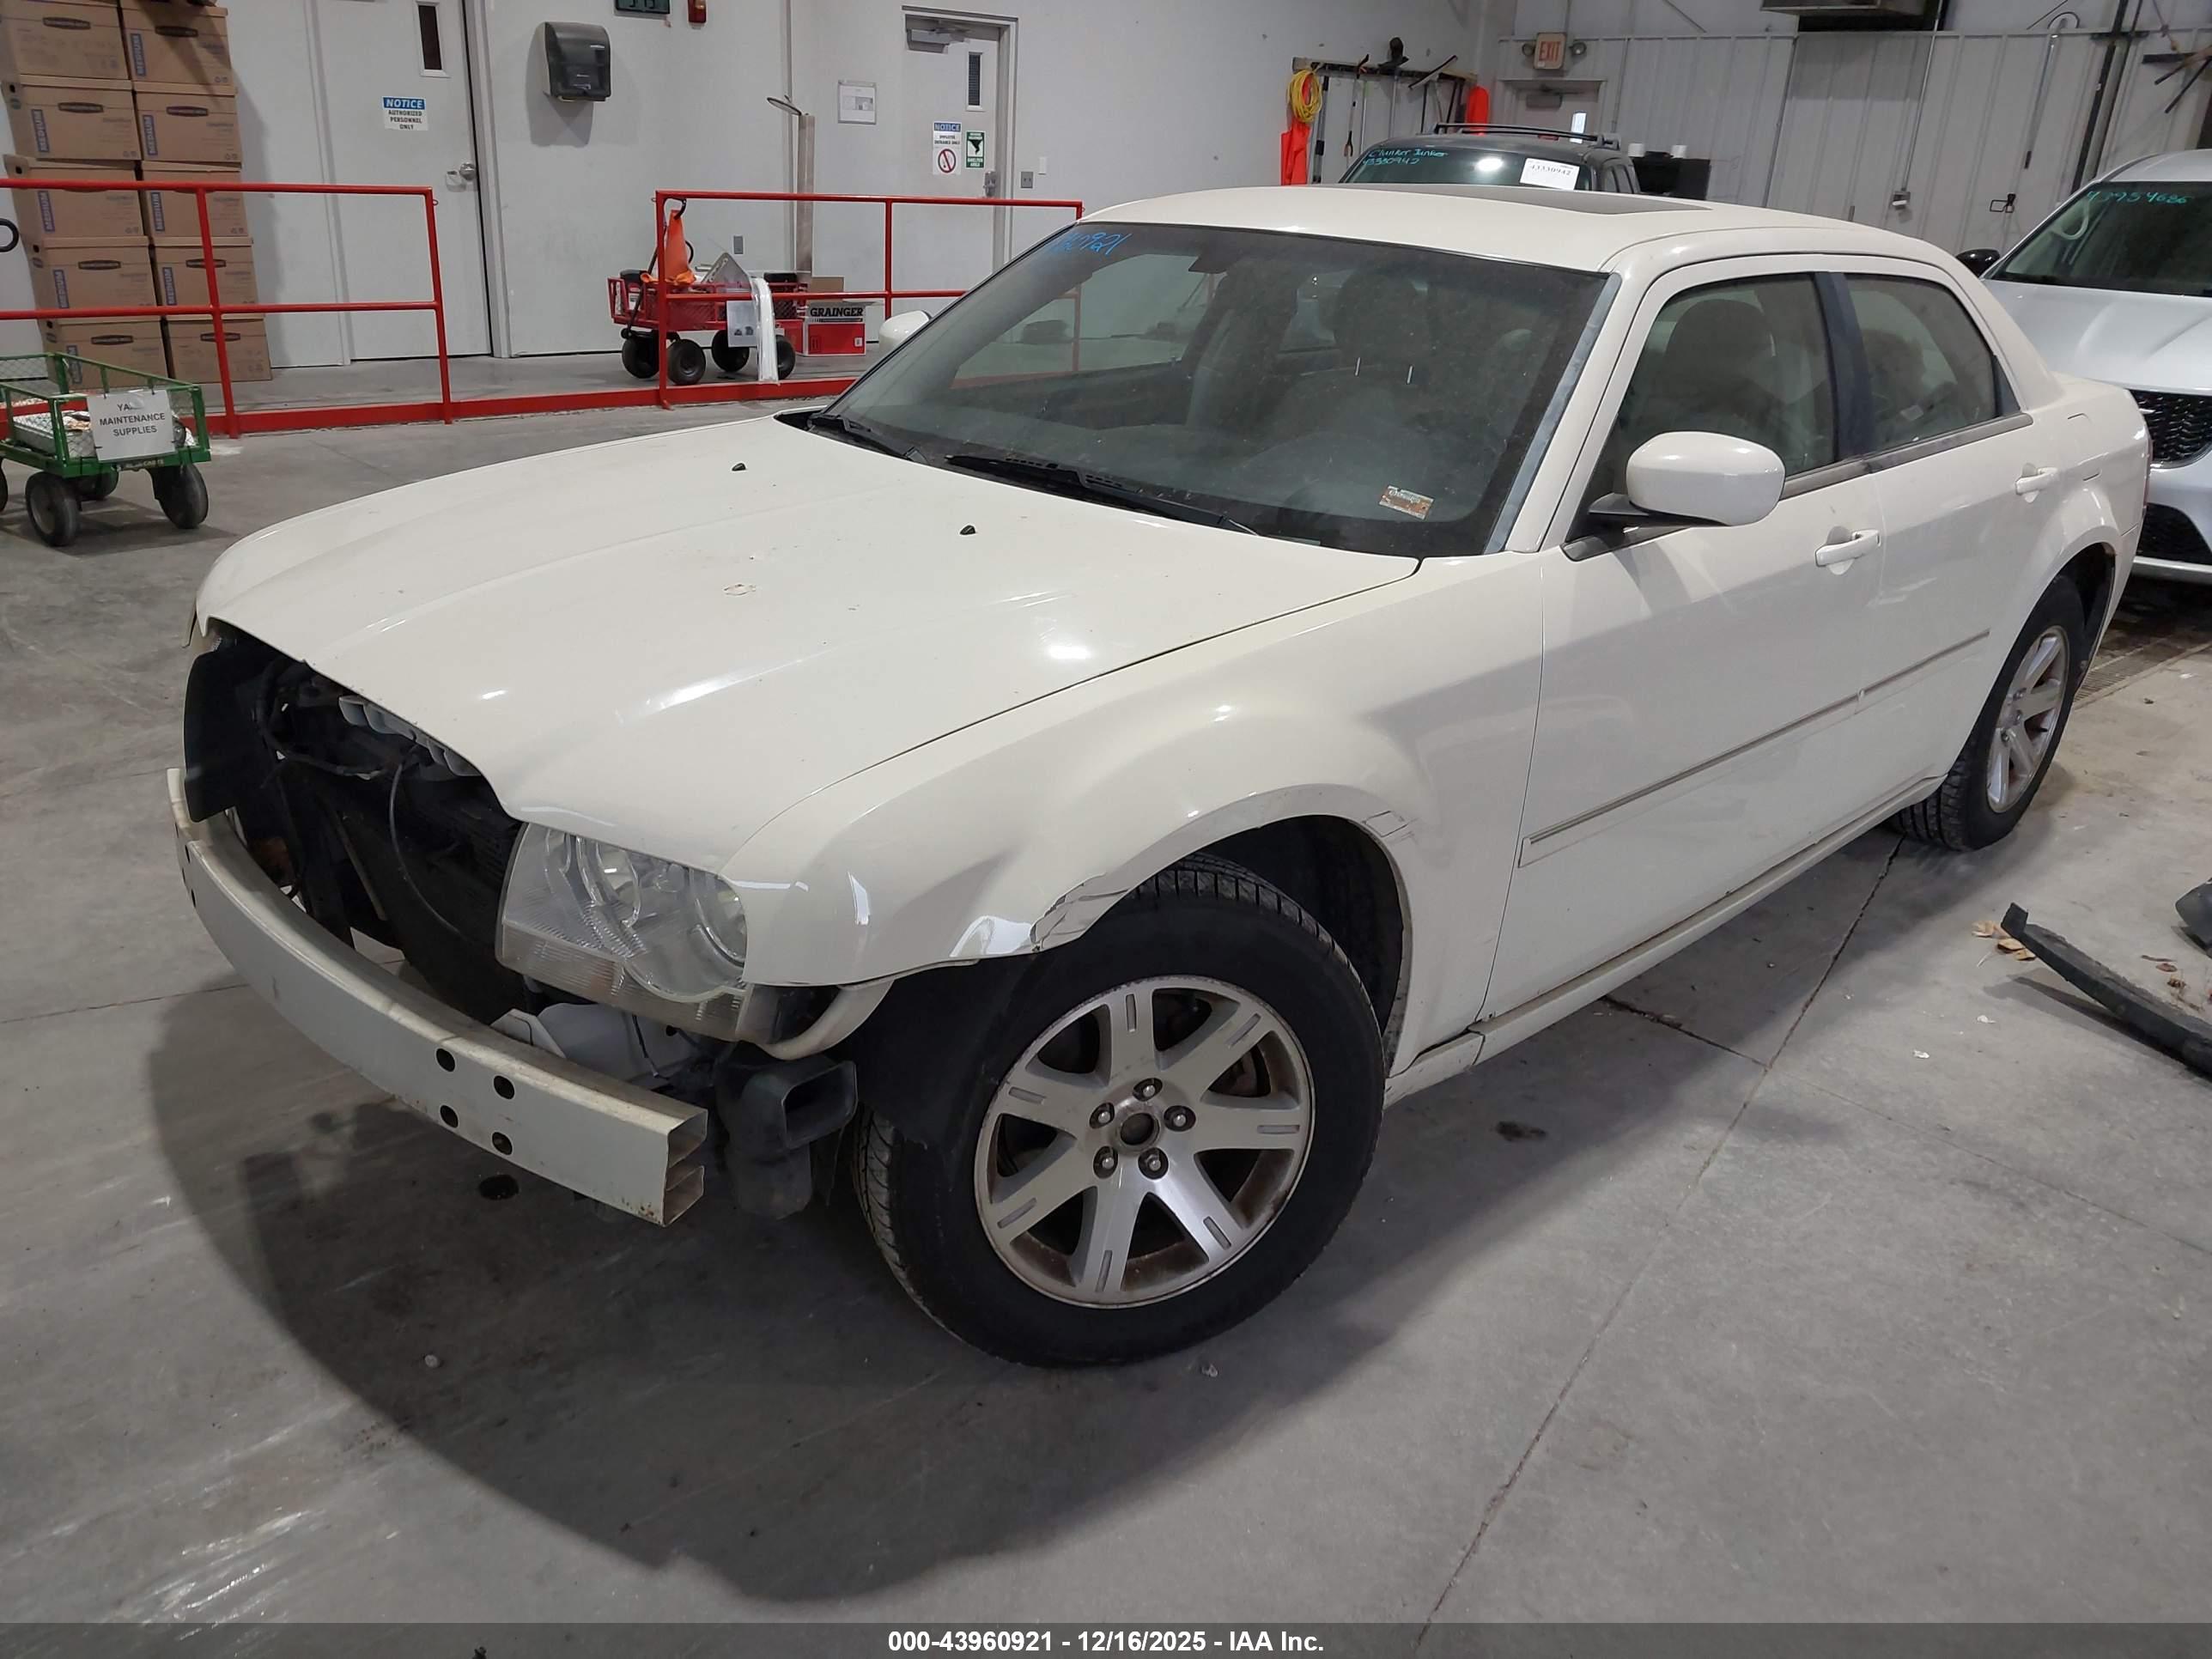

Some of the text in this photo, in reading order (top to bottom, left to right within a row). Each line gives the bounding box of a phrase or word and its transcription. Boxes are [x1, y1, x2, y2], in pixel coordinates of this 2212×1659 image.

[1538, 40, 1561, 62] EXIT
[386, 99, 423, 108] NOTICE
[934, 123, 960, 131] NOTICE
[810, 307, 864, 317] GRAINGER
[99, 413, 166, 426] MAINTENANCE
[112, 425, 158, 437] SUPPLIES
